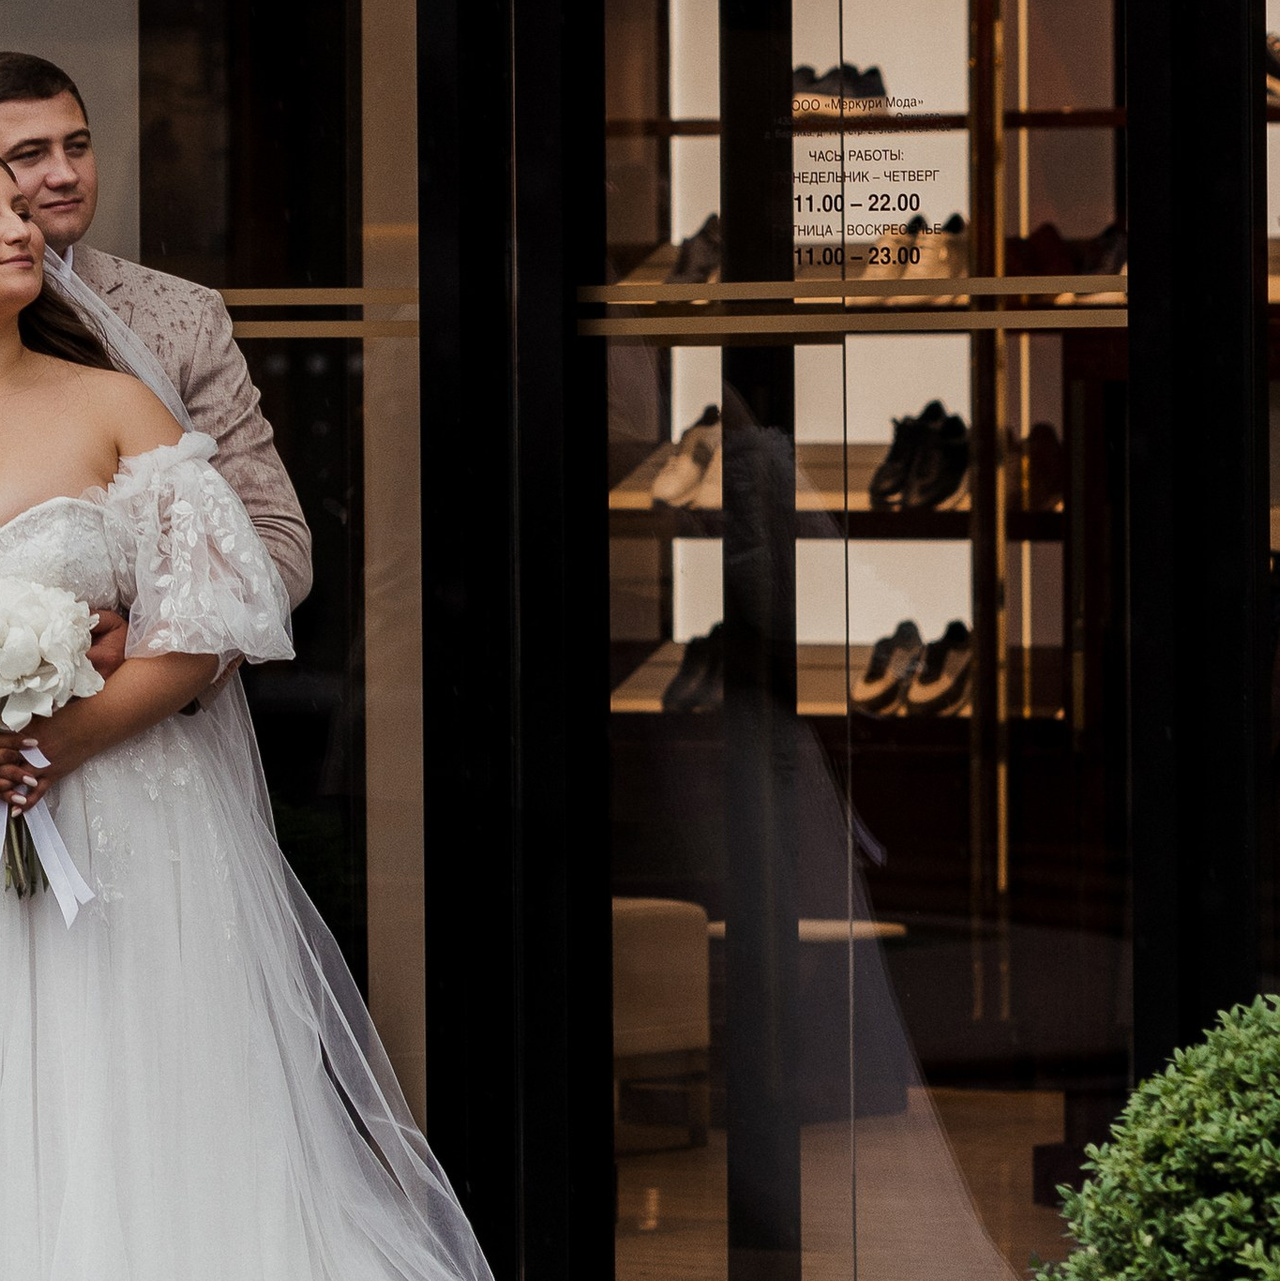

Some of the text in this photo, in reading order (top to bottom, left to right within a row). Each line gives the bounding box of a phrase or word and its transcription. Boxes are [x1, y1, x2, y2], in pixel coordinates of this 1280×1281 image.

[791, 96, 924, 111] ООО «Меркури Мода»
[809, 149, 904, 161] ЧАСЫ РАБОТЫ:
[790, 171, 869, 185] НЕДЕЛЬНИК
[884, 170, 939, 182] ЧЕТВЕРГ
[794, 194, 844, 212] 11.00
[868, 193, 920, 211] 22.00
[790, 224, 833, 238] ТНИЦА
[847, 223, 941, 236] ВОСКРЕСЬЕ
[794, 247, 845, 265] 11.00
[868, 246, 921, 264] 23.00
